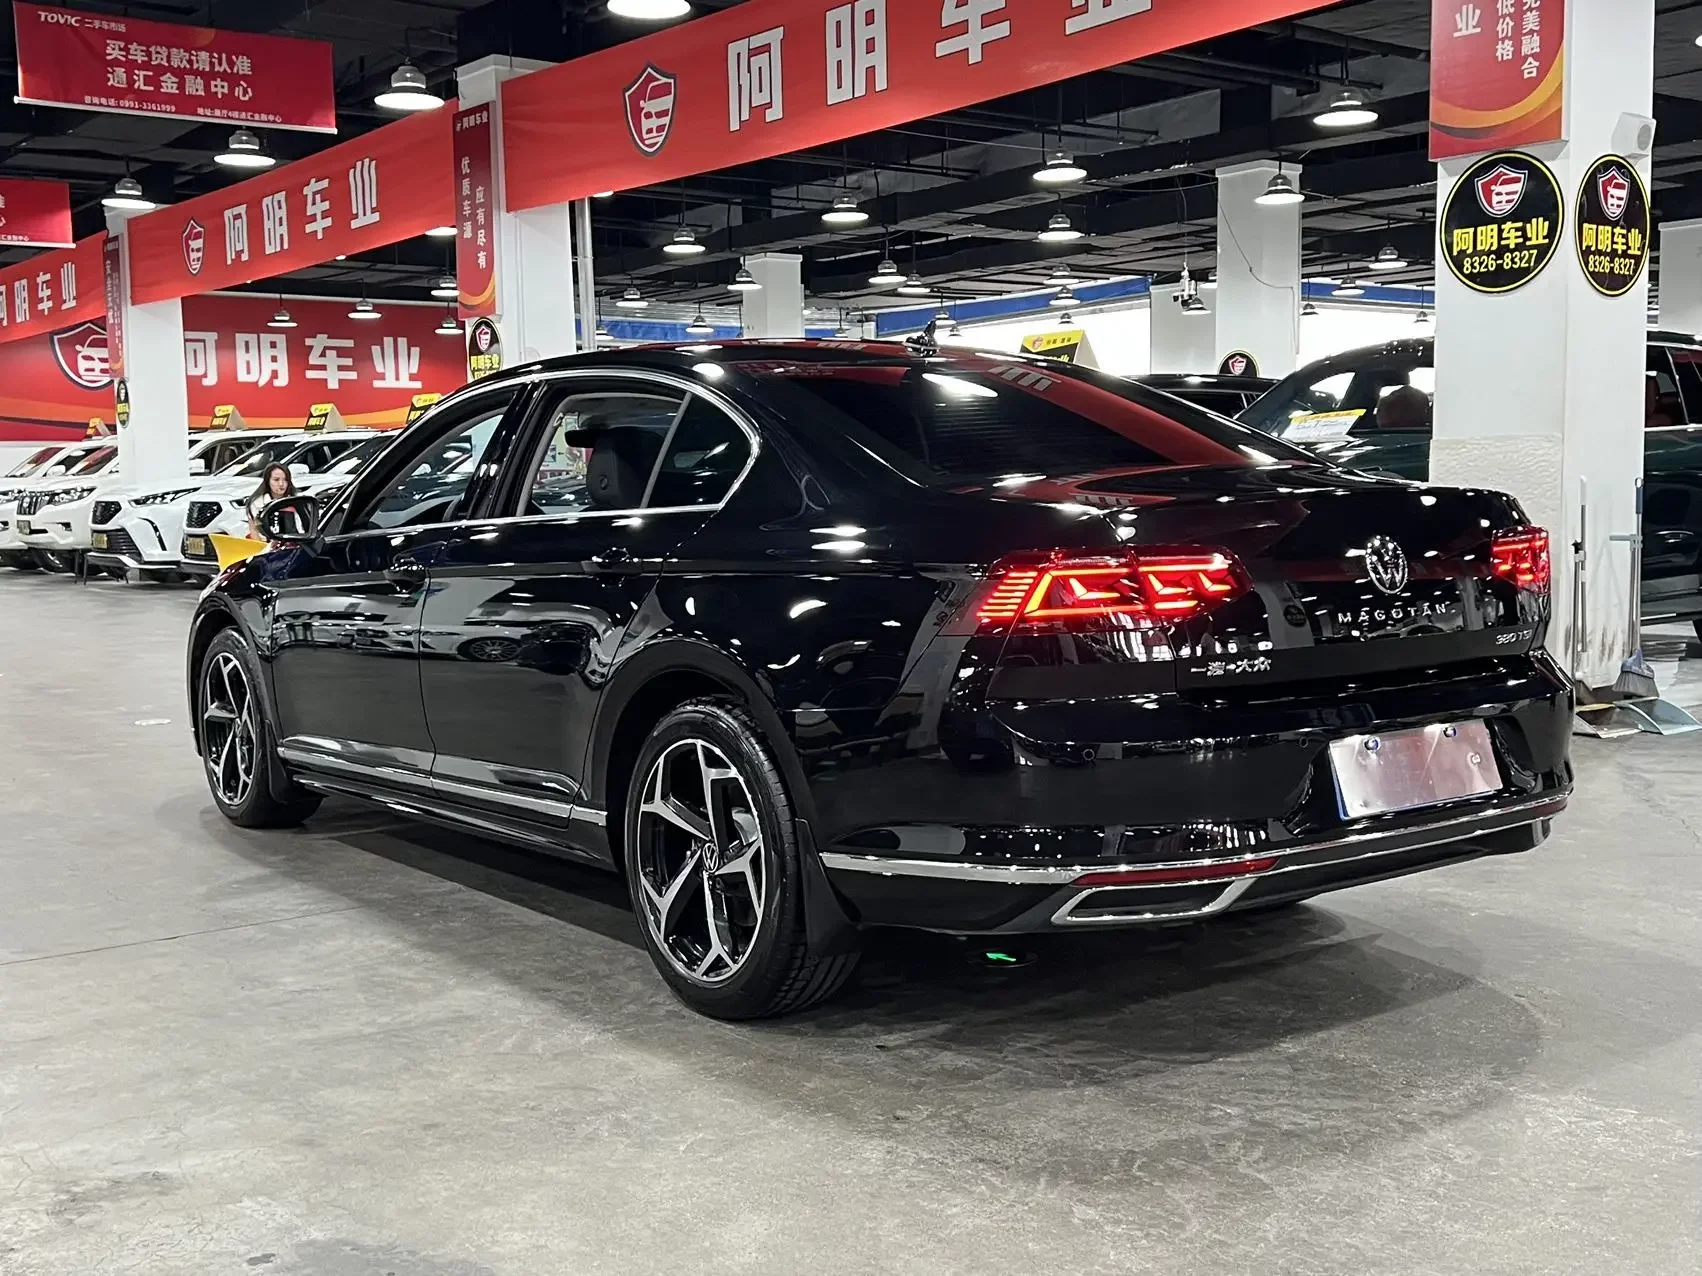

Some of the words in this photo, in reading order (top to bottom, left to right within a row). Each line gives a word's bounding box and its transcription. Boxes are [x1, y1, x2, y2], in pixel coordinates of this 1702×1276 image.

[38, 11, 81, 26] TOVIC
[1453, 3, 1481, 38] 业
[106, 39, 253, 75] 买车贷款请认准
[107, 67, 253, 101] 通汇金融中心
[224, 157, 380, 265] 阿明车业
[461, 156, 473, 239] 优质车源
[476, 186, 487, 269] 应有尽有
[1452, 217, 1549, 256] 阿明车业
[1582, 223, 1642, 256] 阿明车业
[1463, 250, 1538, 275] 8326-8327
[1588, 256, 1635, 275] 8326-8327
[1338, 604, 1446, 624] MAGOTAN
